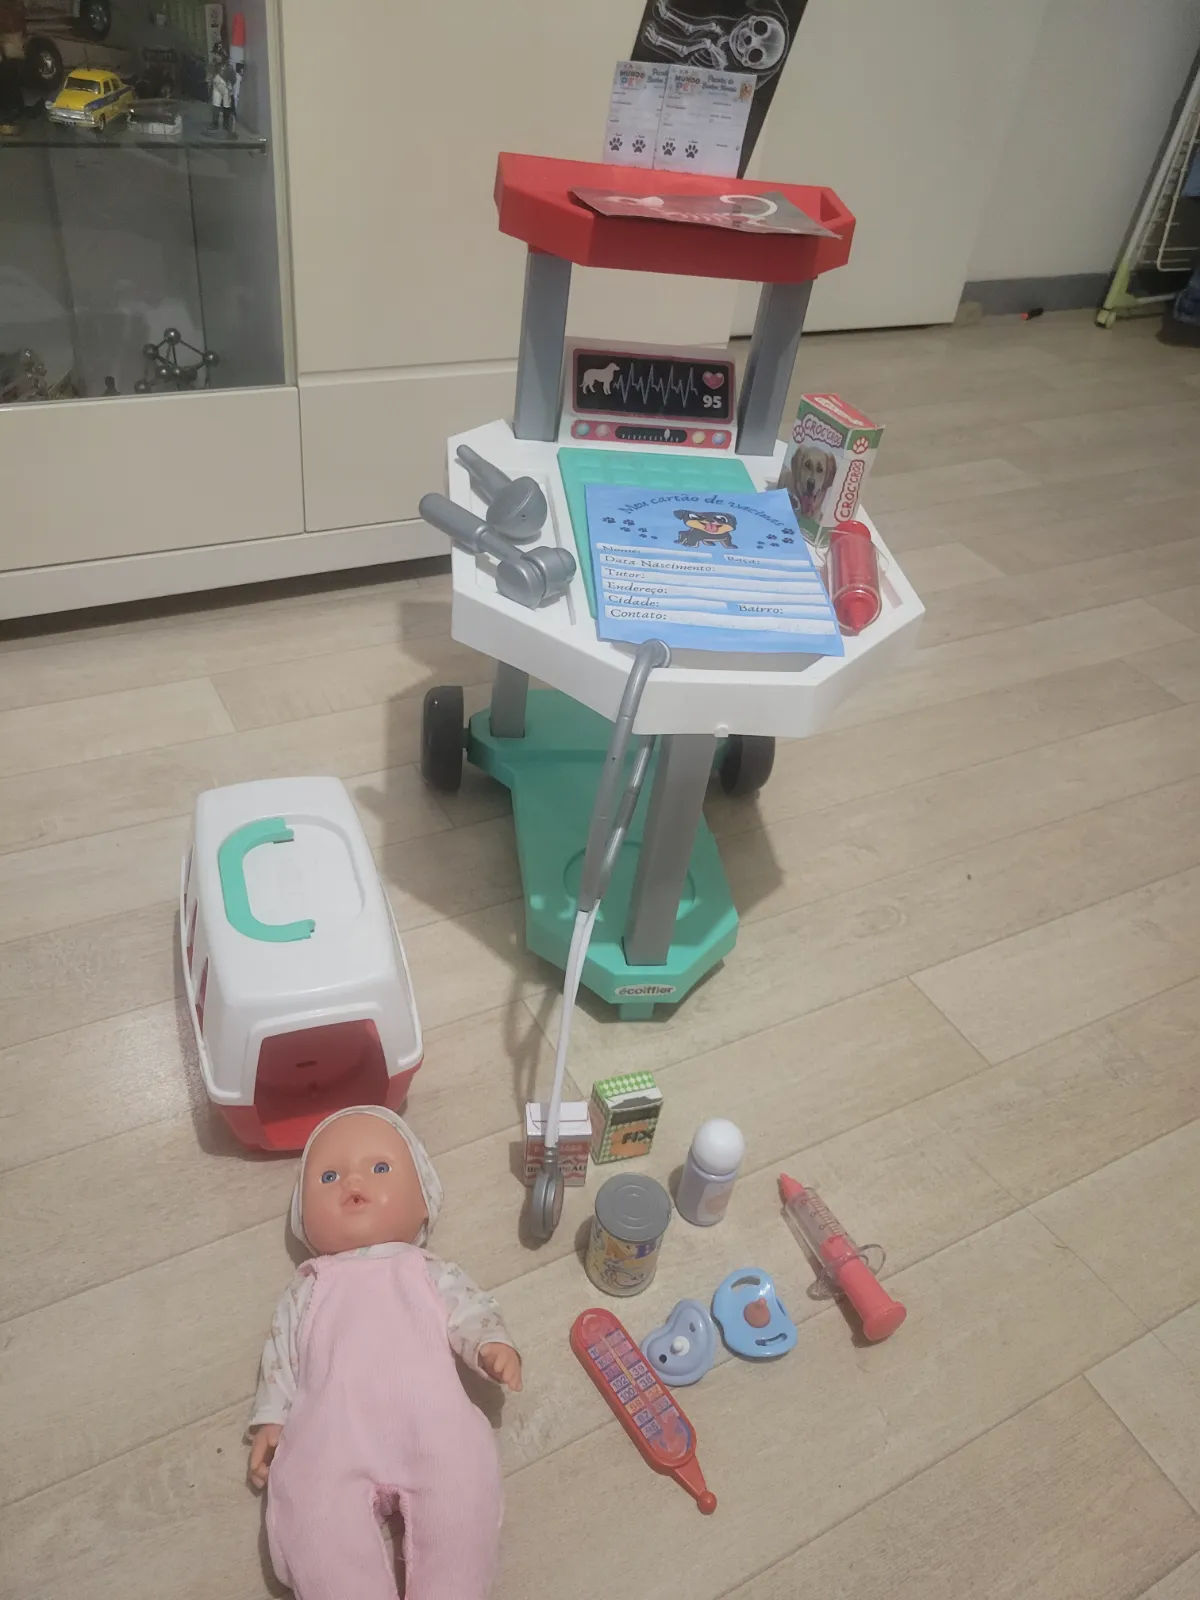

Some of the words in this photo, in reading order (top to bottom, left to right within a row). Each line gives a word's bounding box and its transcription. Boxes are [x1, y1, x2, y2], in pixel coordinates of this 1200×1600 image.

[702, 394, 723, 409] 95
[803, 418, 843, 447] CROC'CROC
[839, 462, 862, 519] CROC'CROC
[617, 500, 650, 515] Meu
[650, 493, 699, 505] cartão
[704, 494, 724, 505] de
[604, 555, 636, 566] Data
[640, 559, 716, 572] Nascimento:
[604, 567, 645, 579] Tutor:
[607, 581, 668, 594] Endereço:
[608, 594, 660, 608] Cidade:
[610, 608, 667, 621] Contato:
[738, 604, 784, 614] Bairro:
[618, 985, 674, 995] écoiffier
[632, 1364, 646, 1377] 39
[611, 1375, 629, 1391] 102
[619, 1387, 636, 1401] 100
